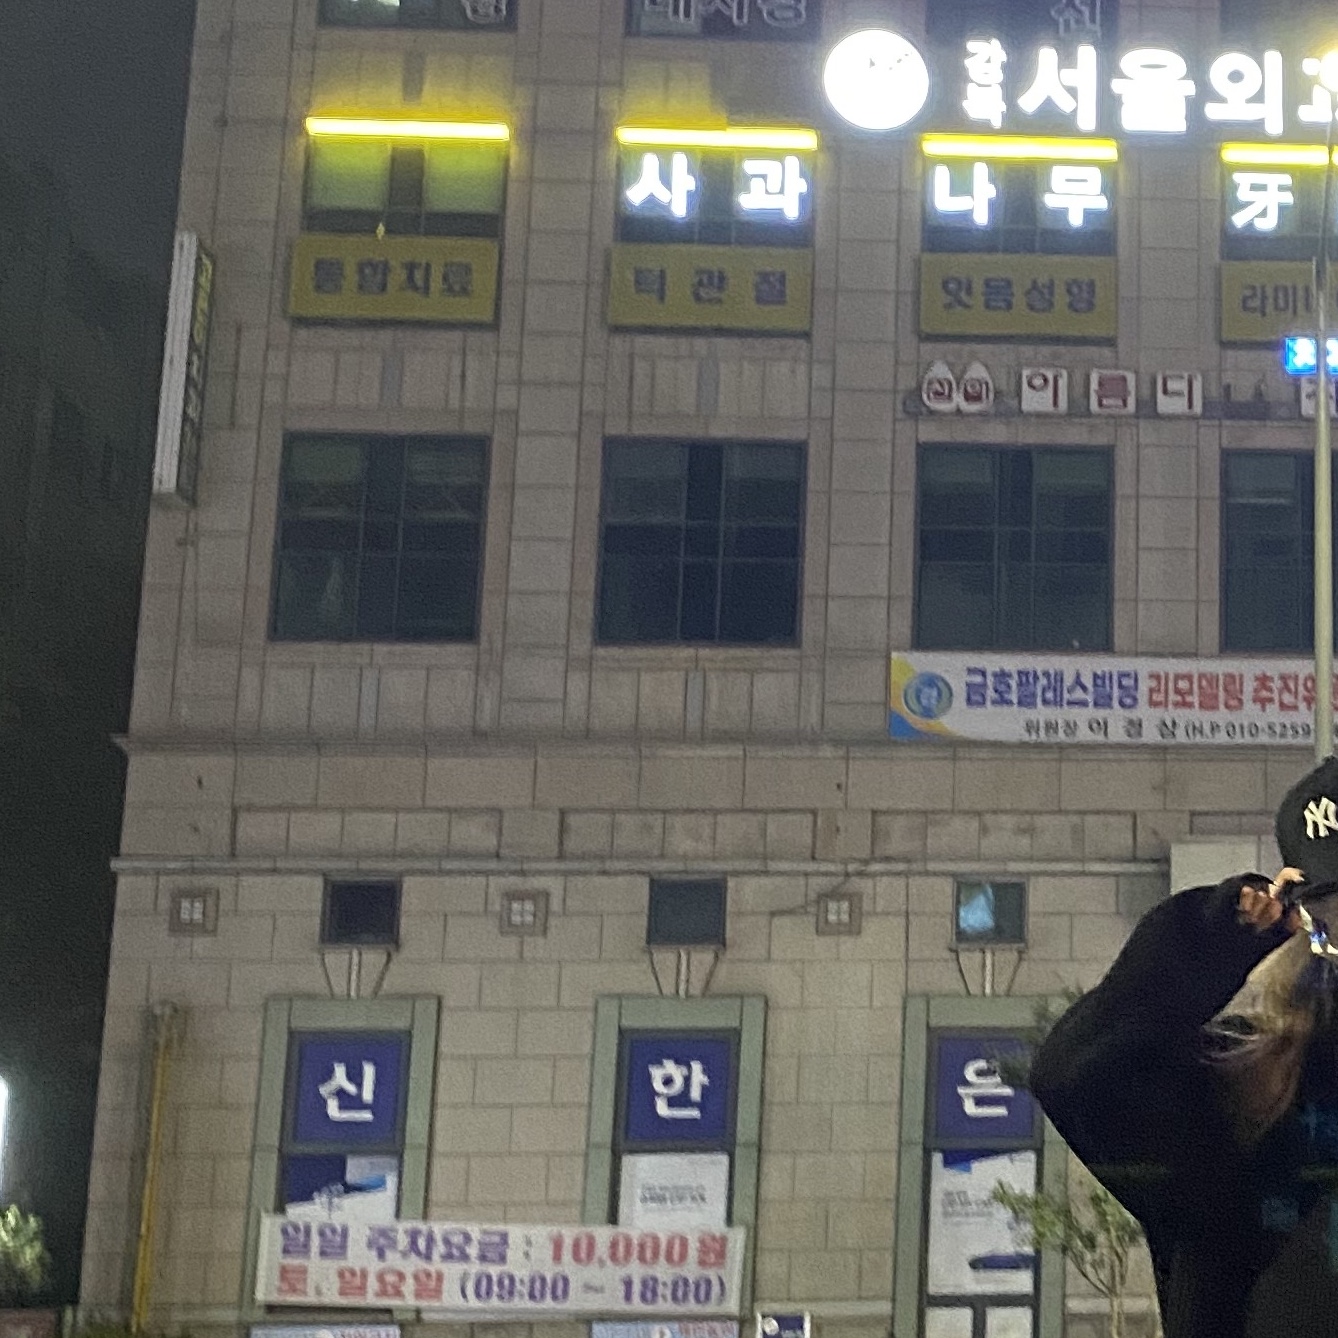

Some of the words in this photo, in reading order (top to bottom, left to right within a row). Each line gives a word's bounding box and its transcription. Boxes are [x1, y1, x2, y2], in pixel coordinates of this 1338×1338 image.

[626, 152, 807, 219] 사과
[934, 161, 1108, 226] 나무
[318, 1061, 375, 1122] 신
[648, 1059, 709, 1120] 한
[957, 1058, 1014, 1117] 은
[337, 1268, 444, 1301] 일요일
[460, 1271, 570, 1304] (09:00
[622, 1272, 726, 1306] 18:00)
